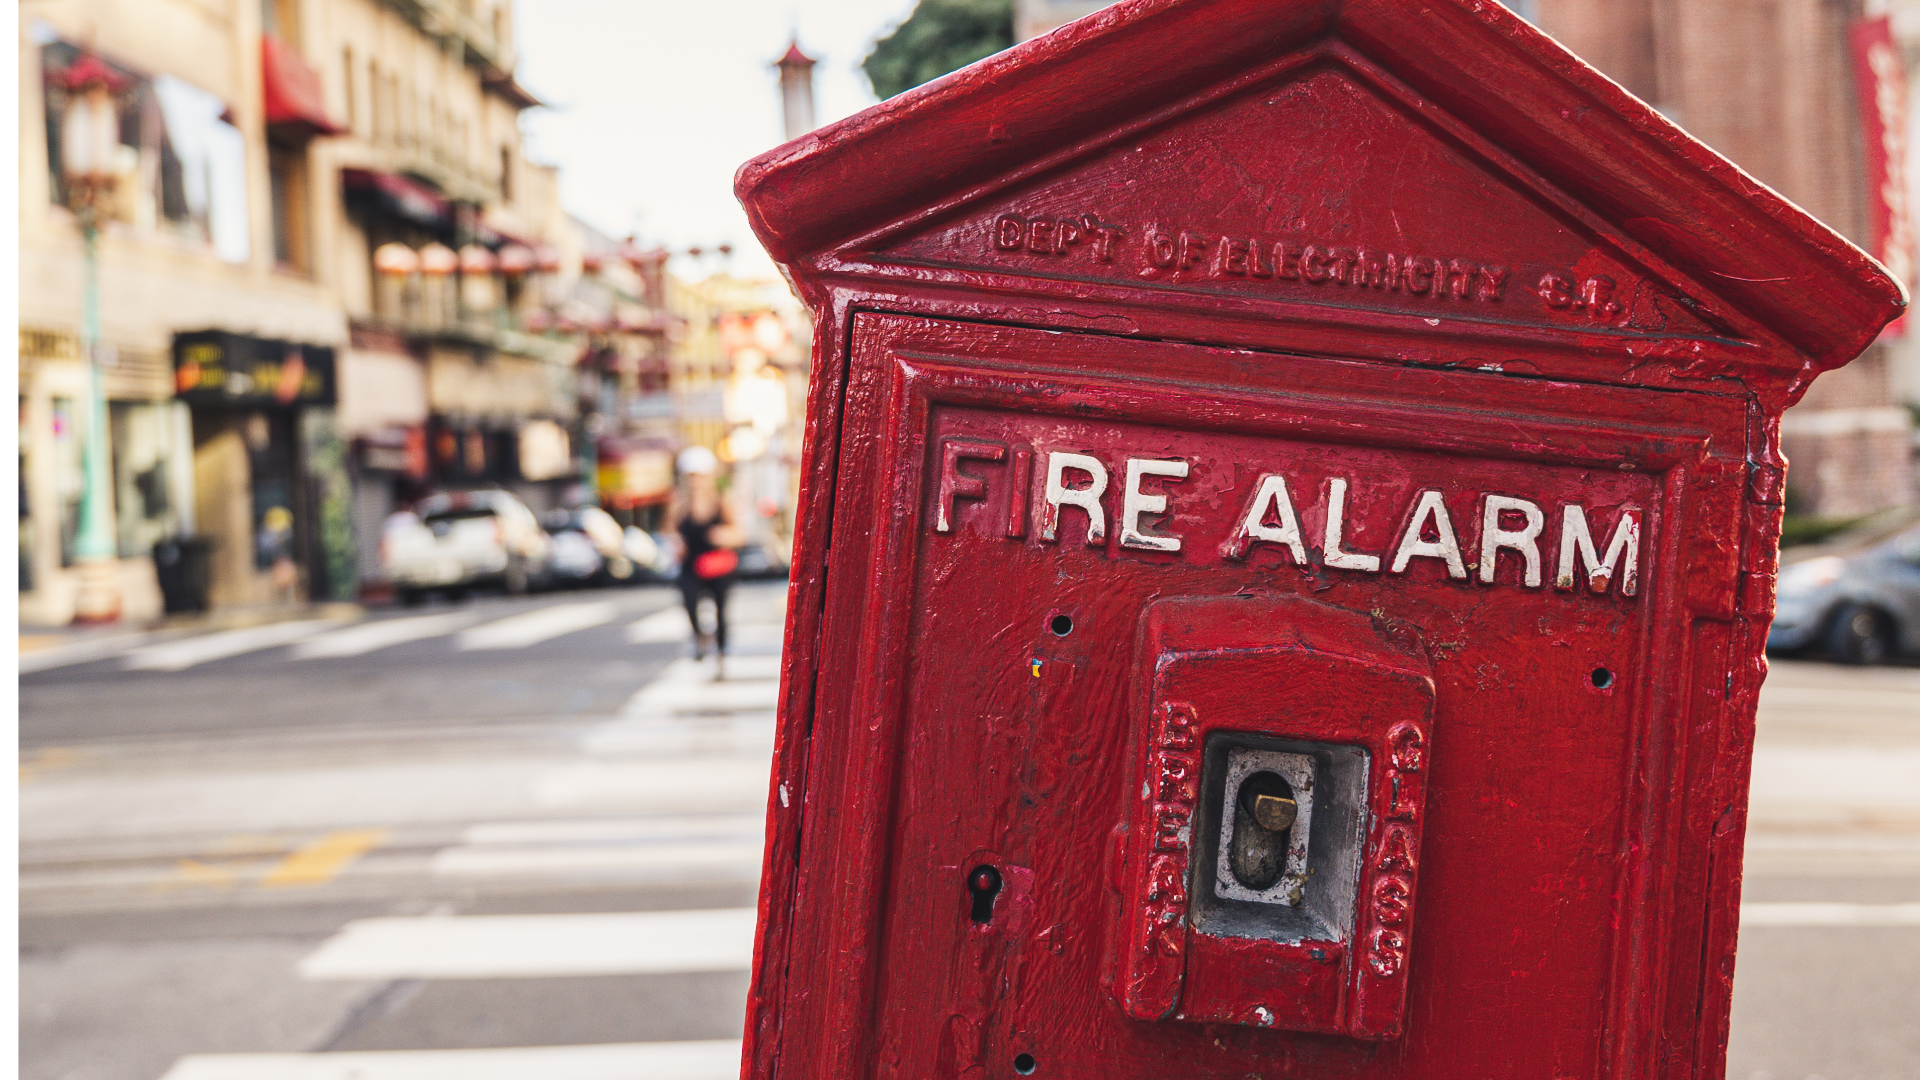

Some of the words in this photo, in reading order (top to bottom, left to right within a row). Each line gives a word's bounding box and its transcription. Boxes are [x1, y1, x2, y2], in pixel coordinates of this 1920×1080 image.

[996, 213, 1124, 262] DEP'T
[1146, 227, 1206, 269] OF
[1218, 235, 1507, 301] ELECTRICITY
[936, 437, 1190, 552] FIRE
[1223, 474, 1643, 597] ALARM
[1145, 701, 1200, 955] BREAK
[1368, 721, 1424, 977] GLASS
